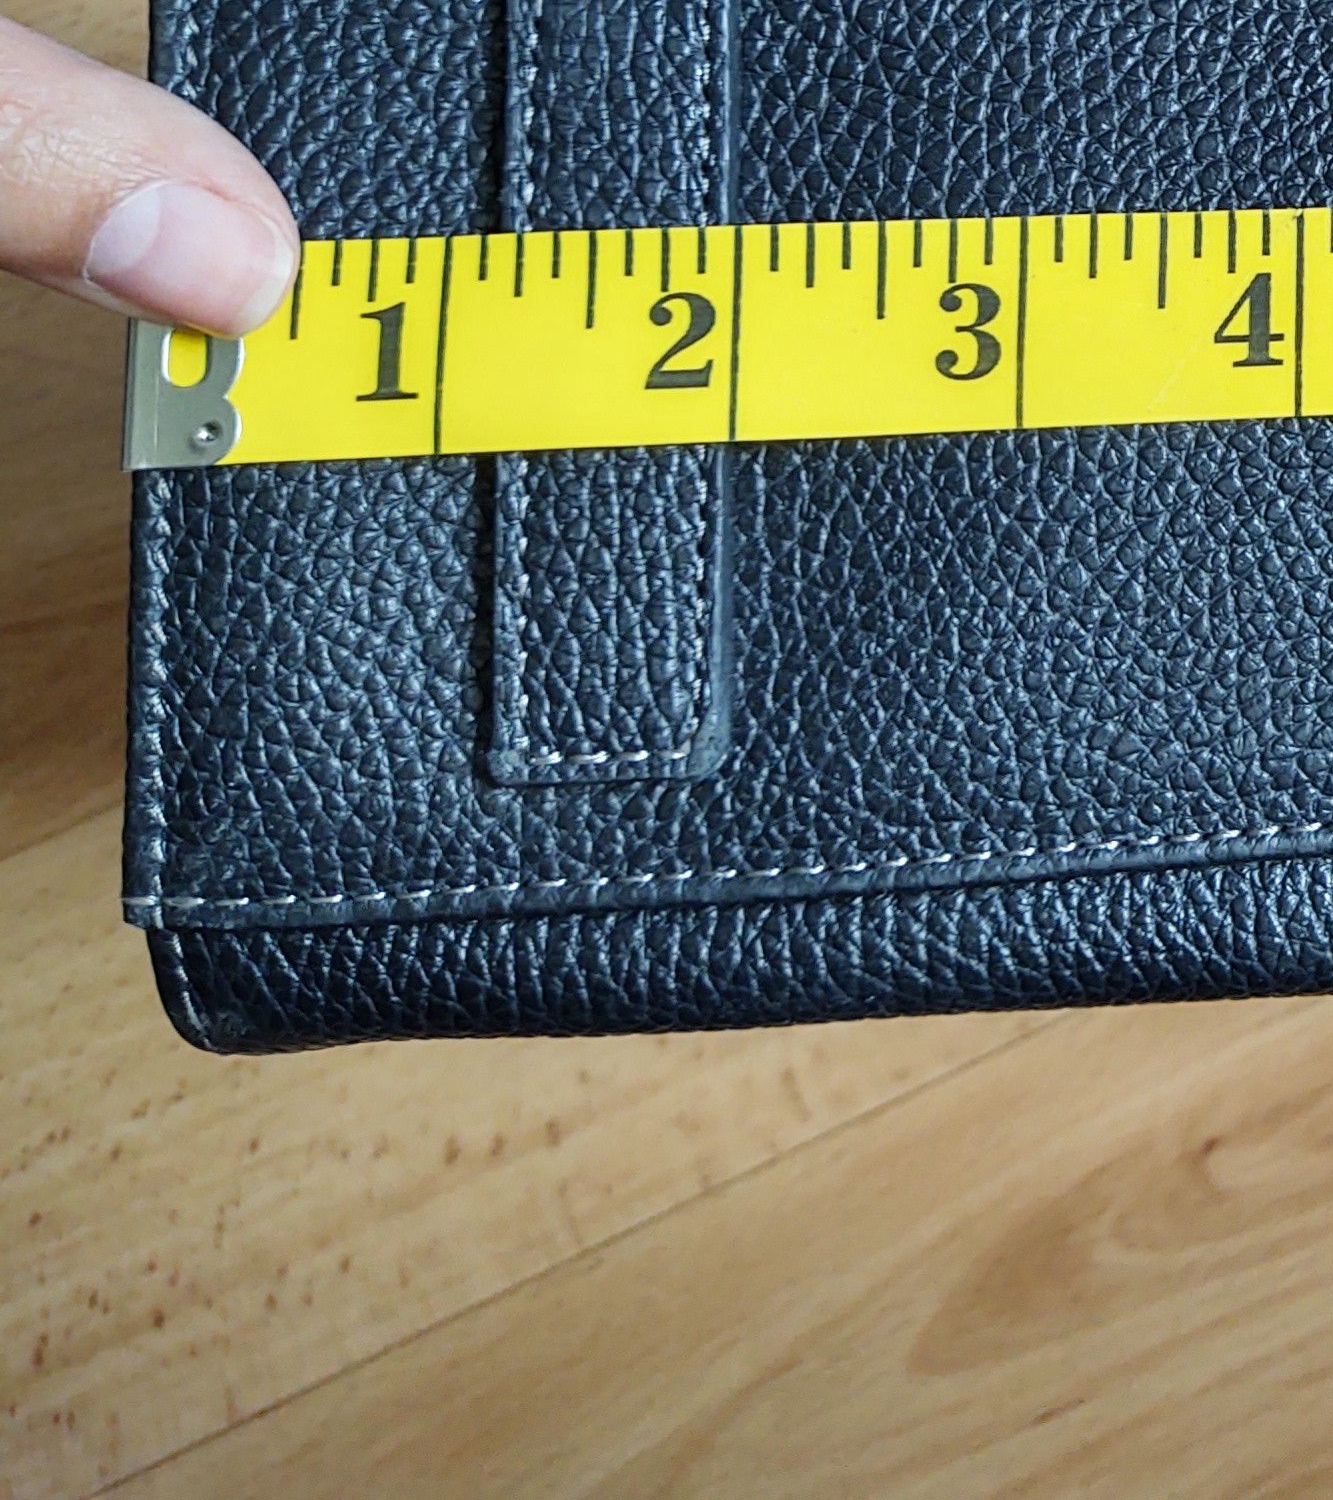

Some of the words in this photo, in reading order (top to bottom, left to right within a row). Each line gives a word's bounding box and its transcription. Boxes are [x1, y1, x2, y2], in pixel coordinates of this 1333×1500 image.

[356, 301, 419, 402] 1
[644, 291, 717, 390] 2
[935, 283, 1002, 381] 3
[1213, 272, 1285, 367] 4
